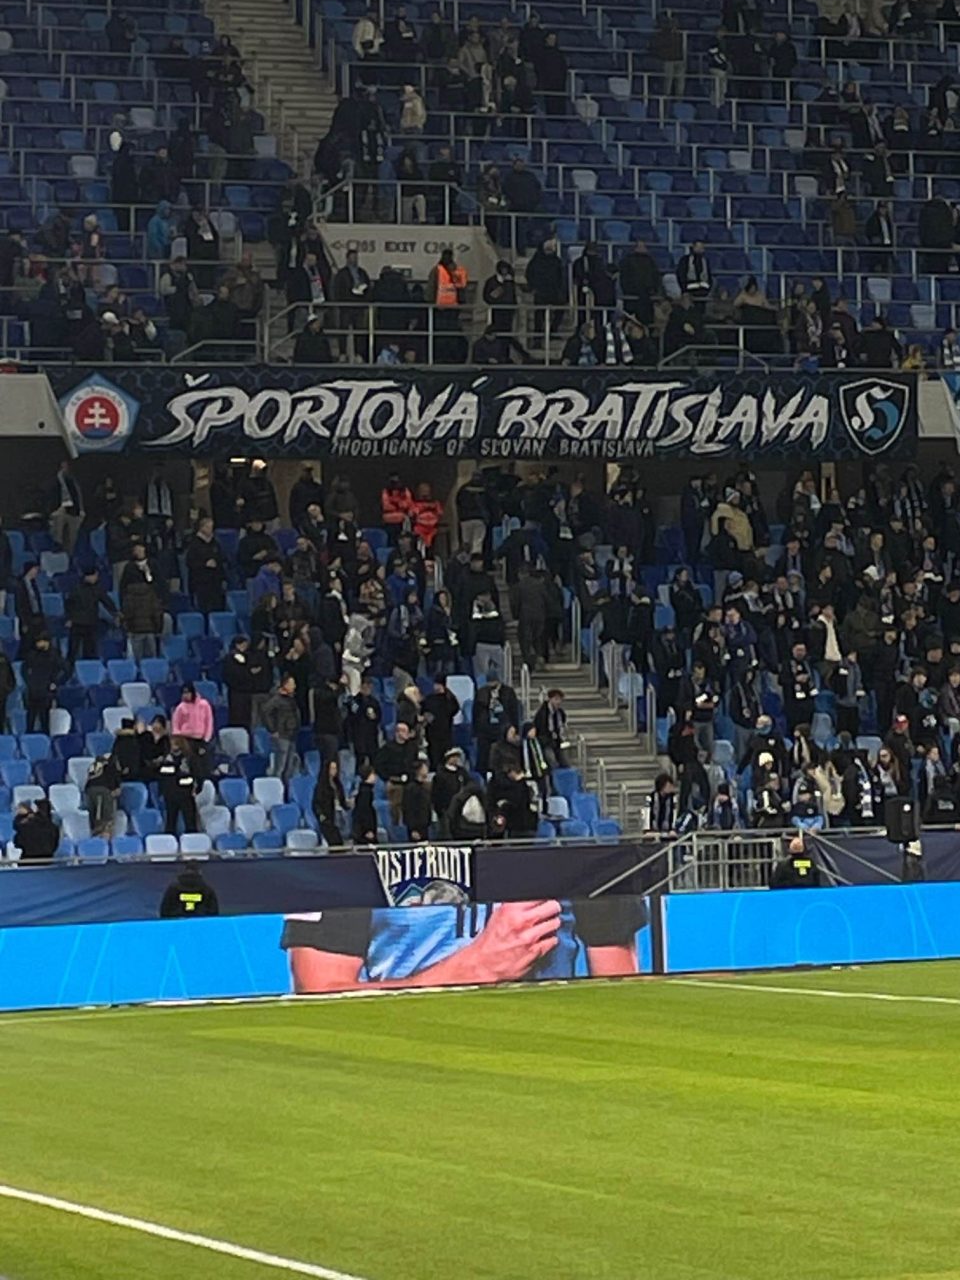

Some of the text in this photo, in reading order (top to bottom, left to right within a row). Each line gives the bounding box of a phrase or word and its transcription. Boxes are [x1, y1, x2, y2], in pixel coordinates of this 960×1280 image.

[384, 241, 417, 253] EXIT
[140, 373, 489, 447] ŠPORTOVÁ
[496, 381, 831, 453] BRATISLAVA
[338, 438, 654, 457] HOOLIGANS OF SLOVAN BRATISLAVA
[377, 846, 472, 888] OSTFRONT
